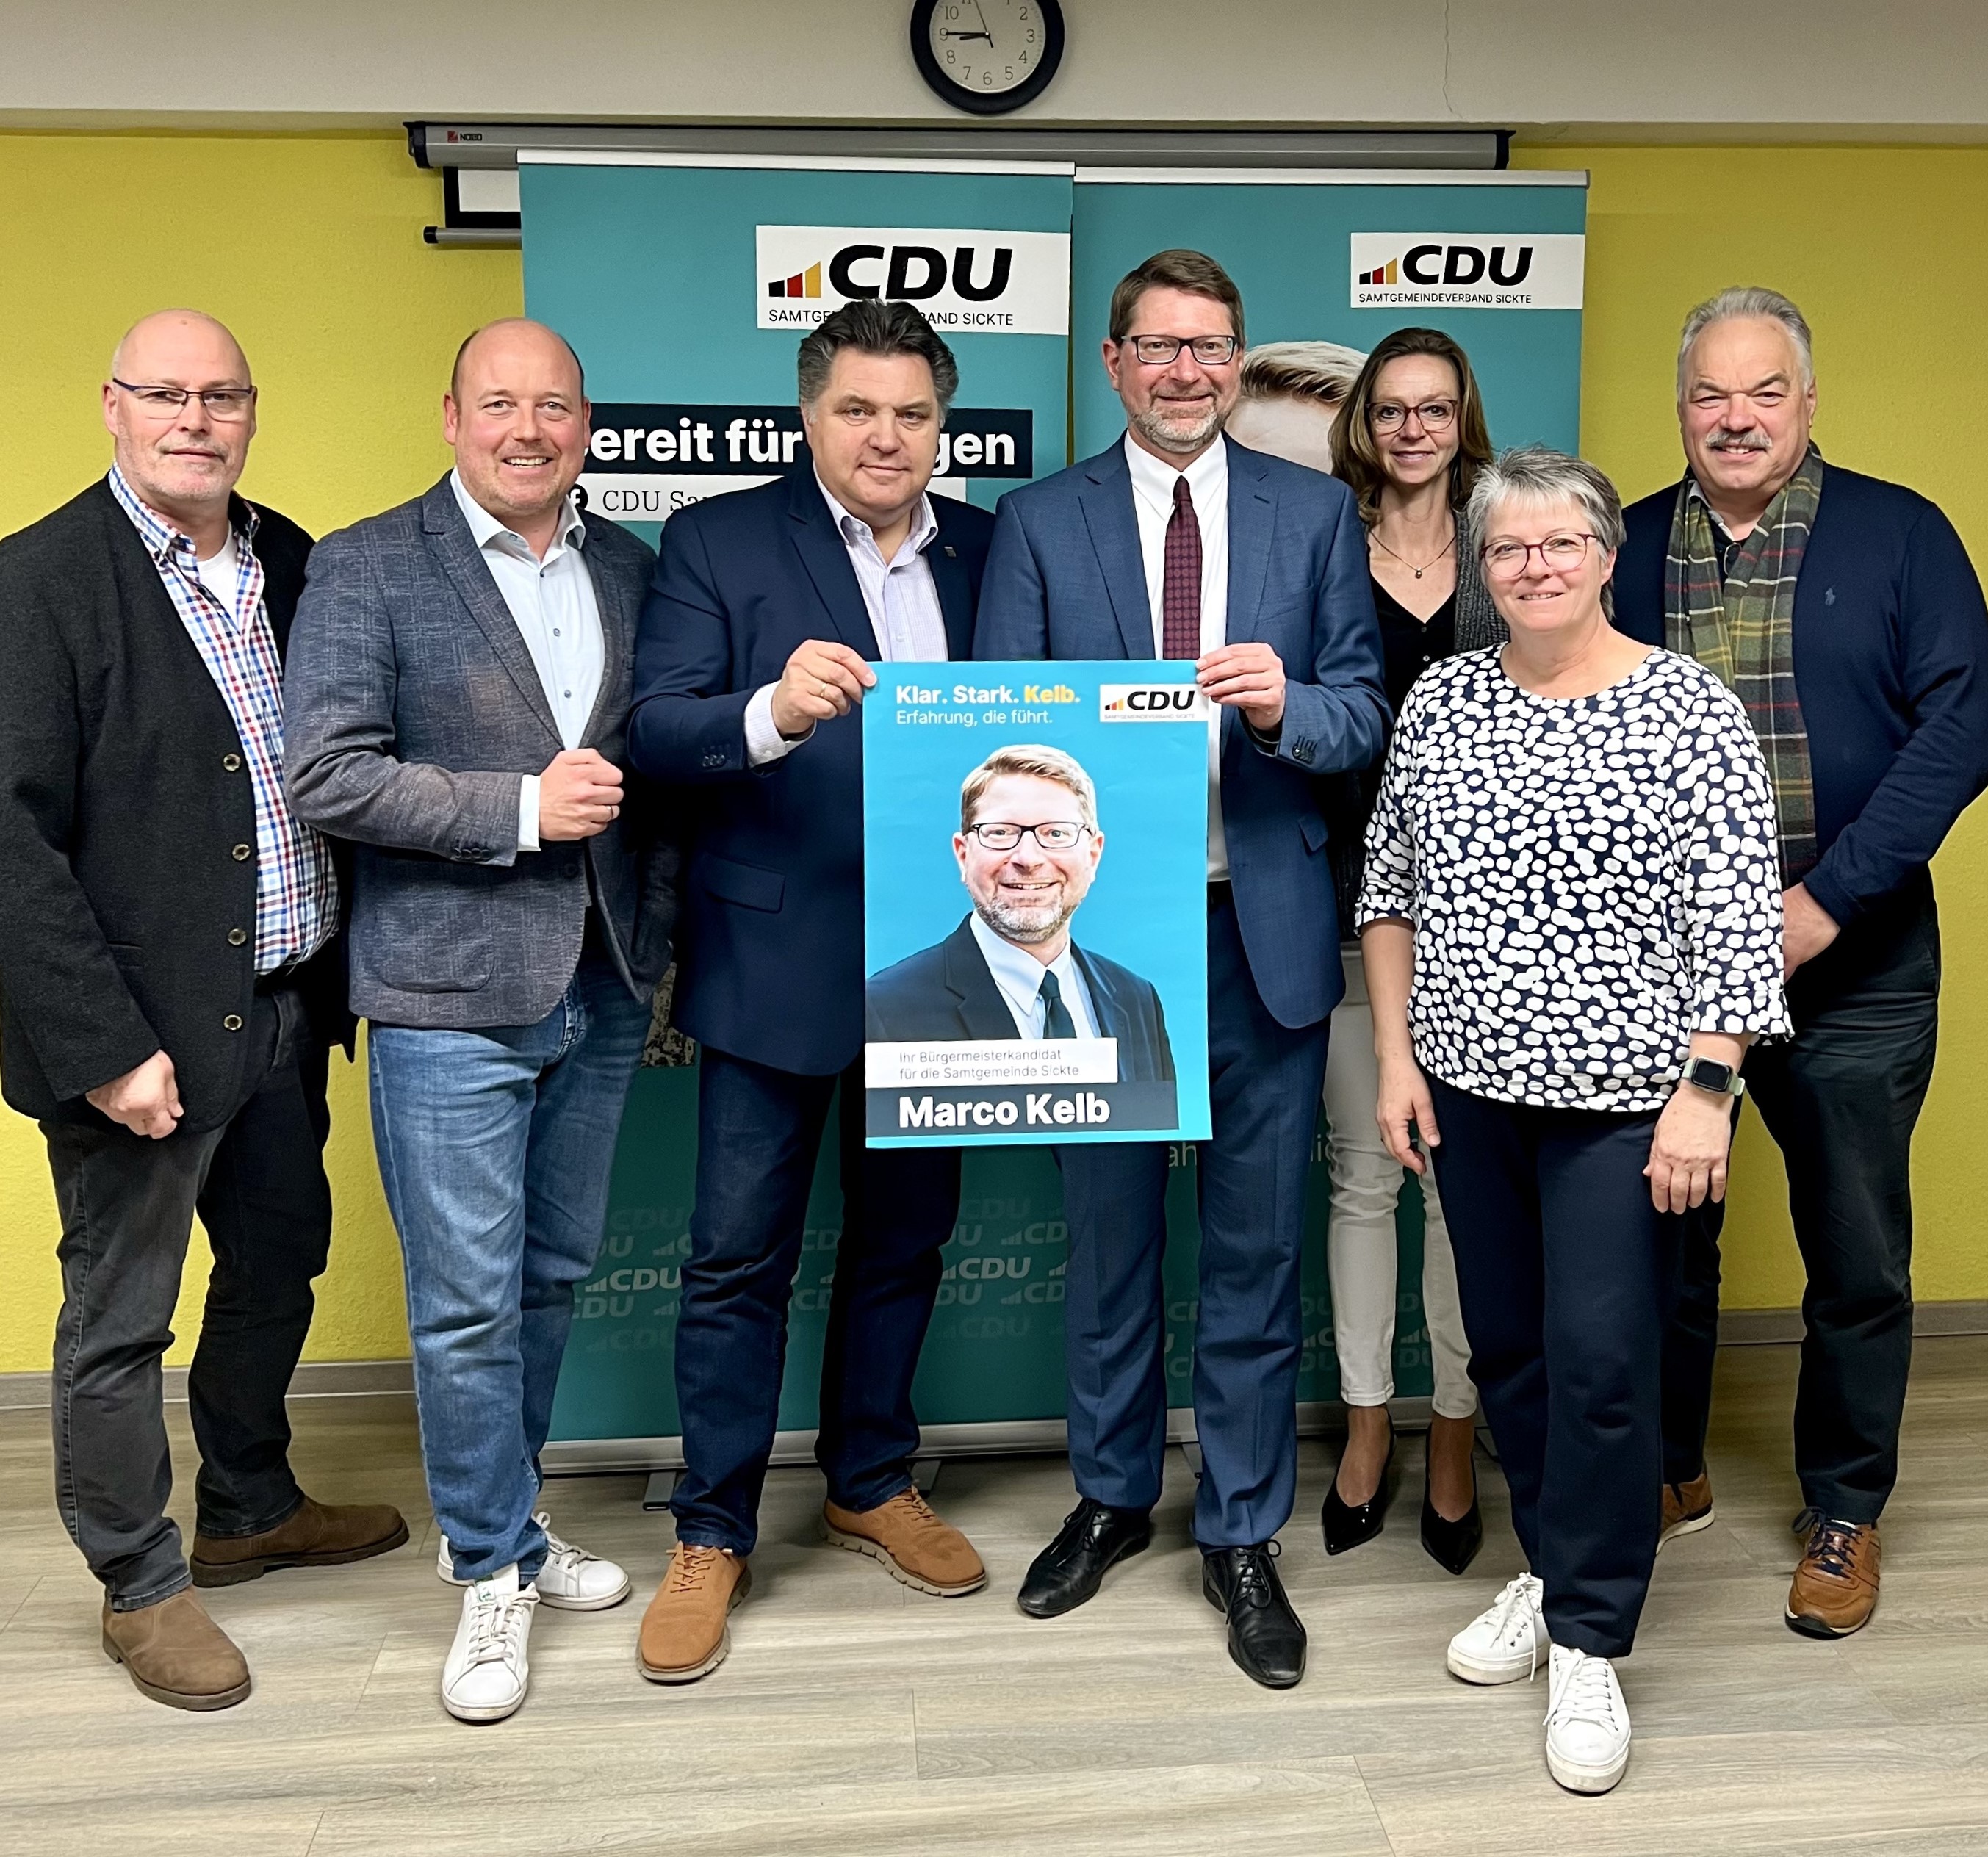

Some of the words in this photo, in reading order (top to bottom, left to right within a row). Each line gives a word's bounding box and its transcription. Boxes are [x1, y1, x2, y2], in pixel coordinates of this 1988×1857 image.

[945, 6, 959, 20] 10
[1019, 7, 1028, 20] 2
[939, 28, 948, 41] 9
[1026, 29, 1035, 43] 3
[946, 50, 956, 64] 8
[1018, 50, 1027, 63] 4
[963, 66, 971, 79] 7
[983, 72, 992, 85] 6
[1004, 66, 1014, 80] 5
[460, 133, 483, 141] NOBO
[829, 245, 1013, 302] CDU
[1402, 245, 1533, 286] CDU
[1359, 293, 1493, 303] SAMTGEMEINDEVERBAND
[1495, 295, 1532, 304] SICKTE
[962, 312, 1014, 326] SICKTE
[585, 417, 714, 462] ereit
[725, 419, 803, 463] für
[602, 490, 660, 512] CDU
[896, 685, 948, 704] Klar.
[953, 685, 1019, 704] Stark.
[1024, 684, 1081, 704] Kelb.
[1127, 690, 1195, 710] CDU
[896, 710, 978, 727] Erfahrung,
[982, 710, 1006, 724] die
[1011, 709, 1053, 724] führt.
[900, 1052, 916, 1063] Ihr
[919, 1049, 1062, 1064] Bürgermeisterkandidat
[900, 1069, 918, 1080] für
[921, 1068, 940, 1079] die
[944, 1065, 1037, 1081] Samtgemeinde
[1042, 1064, 1079, 1076] Sickte
[899, 1095, 1018, 1128] Marco
[1026, 1092, 1110, 1125] Kelb
[1024, 1221, 1068, 1244] CD
[958, 1256, 1031, 1280] CDU
[609, 1267, 682, 1291] CDU
[1024, 1280, 1066, 1304] CD
